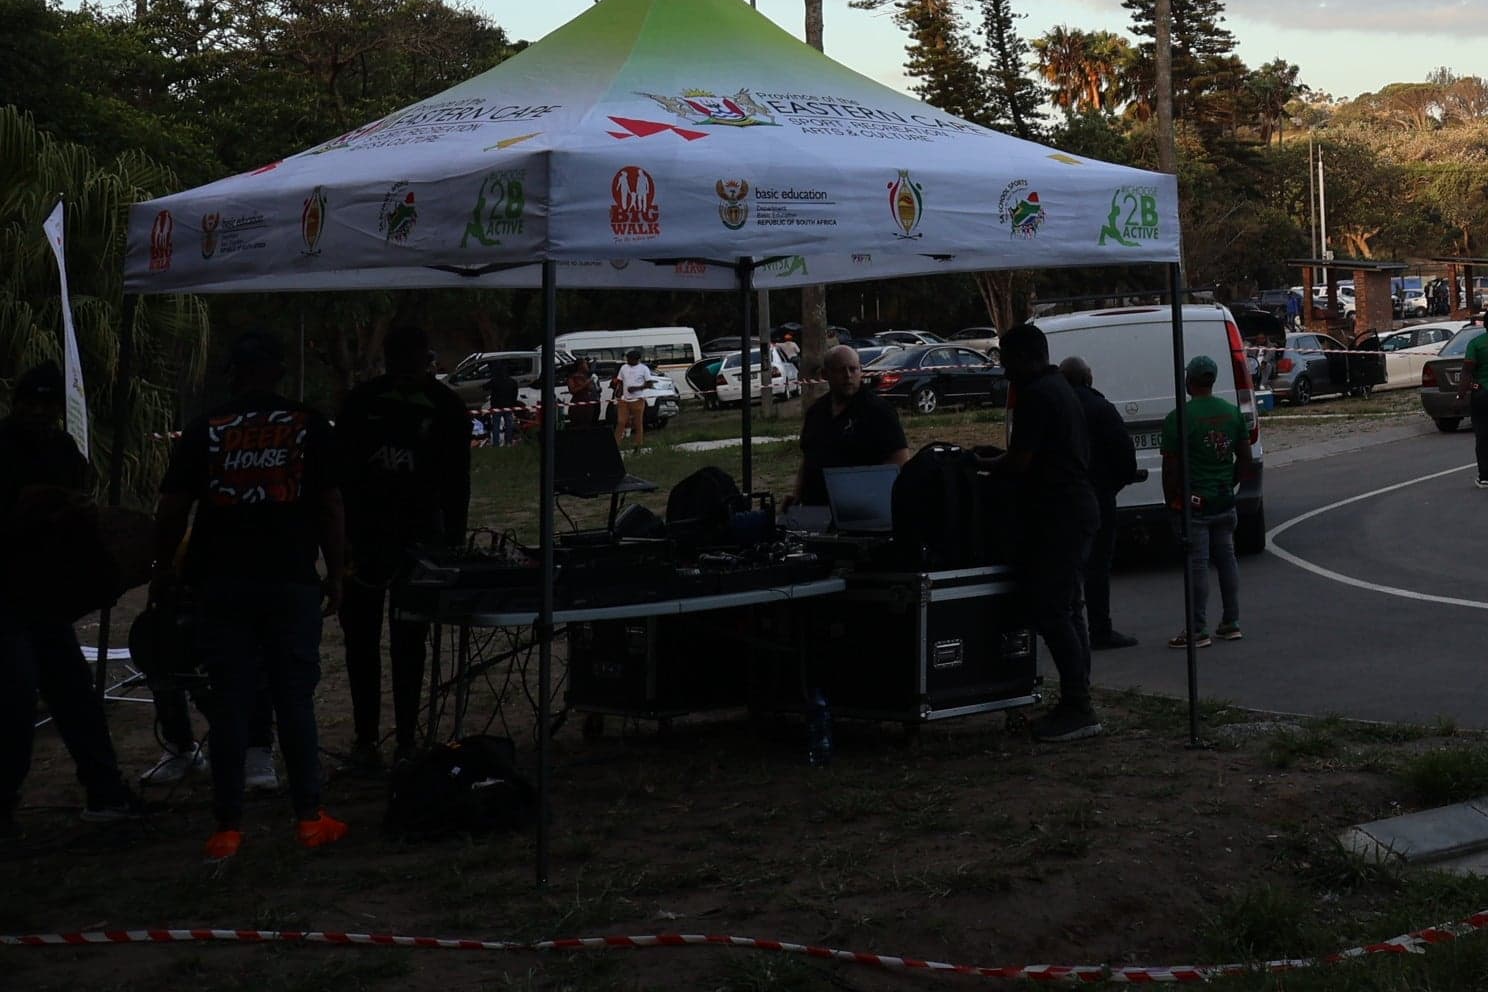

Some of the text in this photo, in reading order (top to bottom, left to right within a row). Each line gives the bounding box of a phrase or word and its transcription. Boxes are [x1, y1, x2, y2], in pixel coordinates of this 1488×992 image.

[767, 100, 908, 123] EASTERN
[755, 187, 828, 200] basic education
[610, 205, 659, 223] BIG
[1123, 193, 1159, 226] 2B
[486, 219, 523, 236] ACTIVE
[610, 223, 661, 235] WALK
[1122, 226, 1159, 239] ACTIVE
[224, 447, 290, 471] HOUSE
